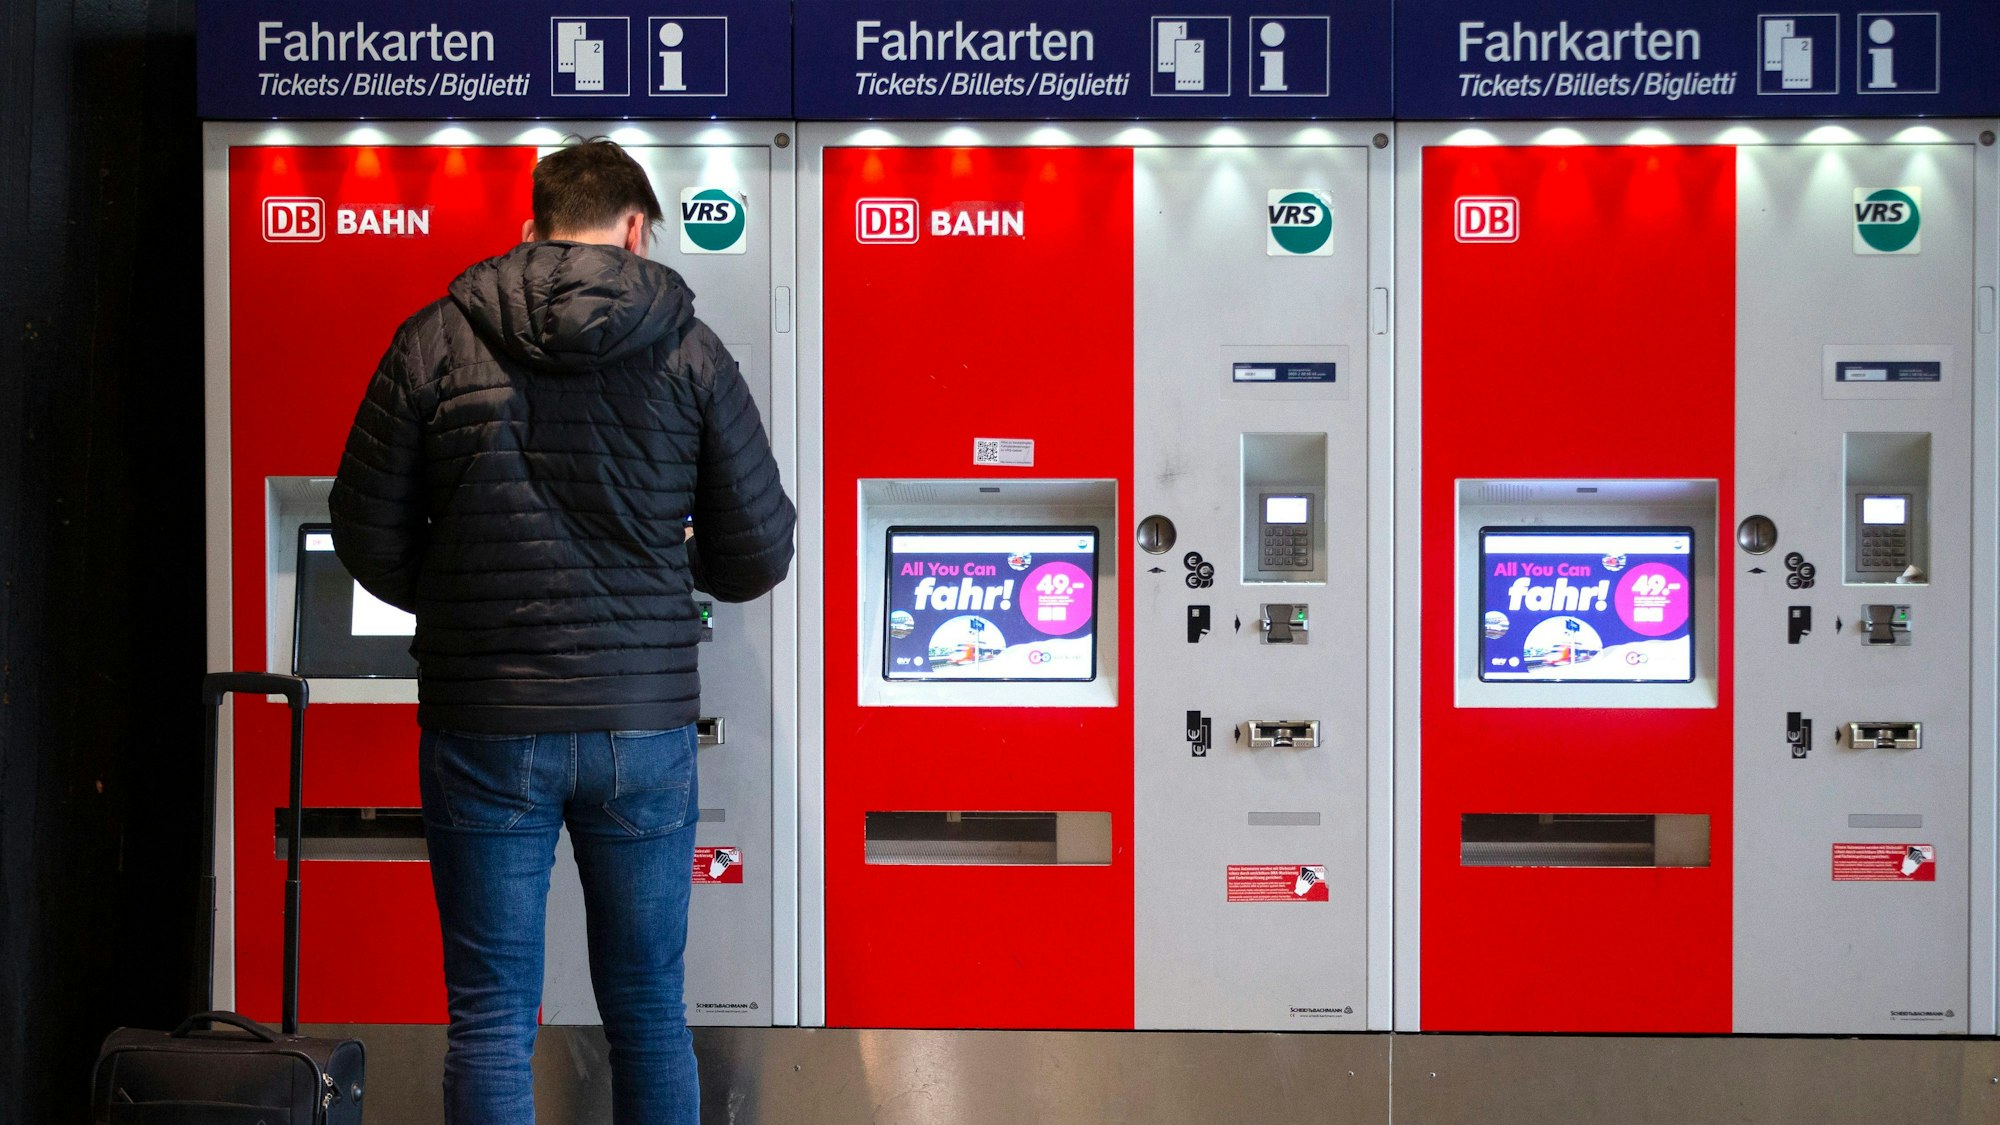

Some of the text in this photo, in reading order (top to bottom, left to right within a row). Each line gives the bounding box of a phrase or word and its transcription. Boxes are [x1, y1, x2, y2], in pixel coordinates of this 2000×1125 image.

[259, 22, 494, 62] Fahrkarten
[857, 21, 1094, 62] Fahrkarten
[1459, 22, 1700, 63] Fahrkarten
[272, 206, 429, 236] DB BAHN
[681, 201, 729, 223] VRS
[866, 207, 1024, 236] DB BAHN
[1268, 204, 1318, 226] VRS
[1465, 206, 1509, 234] DB
[1854, 202, 1904, 224] VRS
[901, 562, 997, 577] All You Can
[1494, 562, 1591, 577] All You Can
[914, 577, 1015, 611] fahr!
[1508, 577, 1611, 612] fahr!
